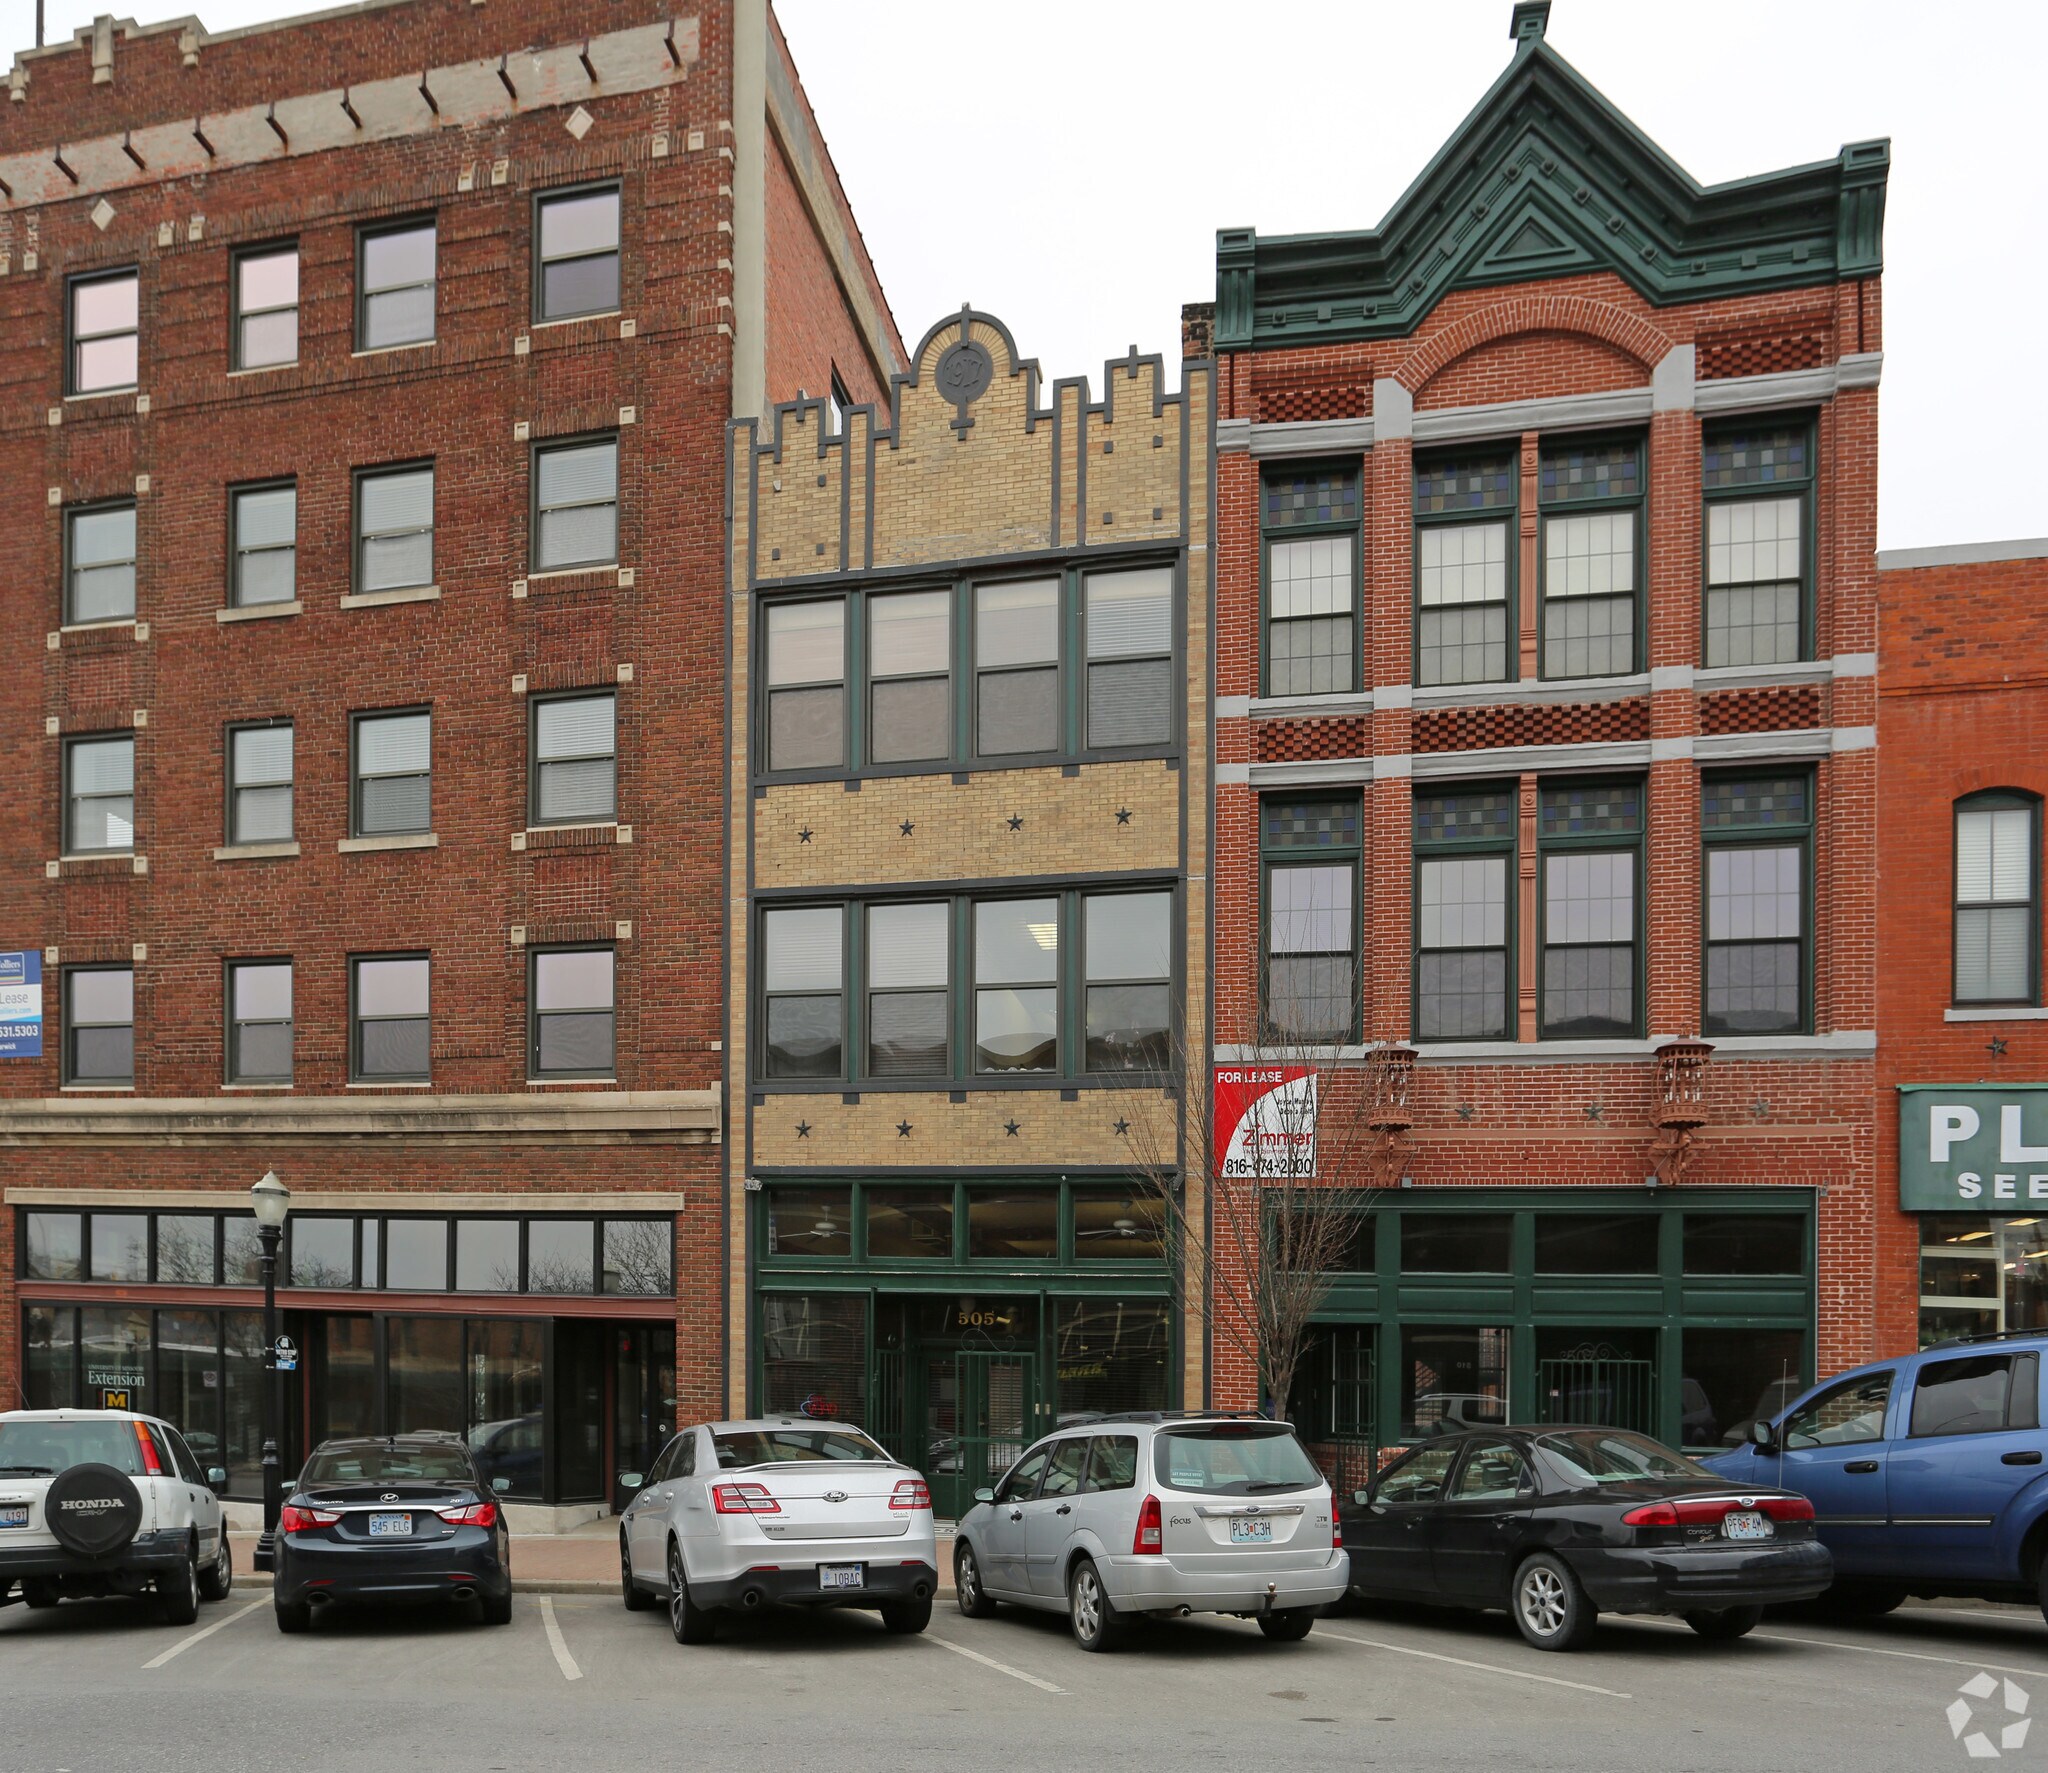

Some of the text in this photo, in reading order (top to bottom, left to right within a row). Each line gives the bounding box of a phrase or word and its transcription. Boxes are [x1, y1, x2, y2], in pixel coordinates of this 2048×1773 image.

[1217, 1071, 1283, 1084] FOR LEASE
[1242, 1125, 1313, 1146] Zmmer
[1226, 1158, 1311, 1175] 816-74-200
[1957, 1172, 2048, 1199] SEE
[958, 1311, 995, 1326] 505
[88, 1370, 145, 1387] Extension
[107, 1393, 126, 1407] M
[60, 1498, 125, 1509] HONDA
[371, 1521, 409, 1532] 545 ELG
[1169, 1515, 1192, 1528] focus
[1728, 1518, 1744, 1534] PF8
[1232, 1522, 1271, 1536] PL3 C3H
